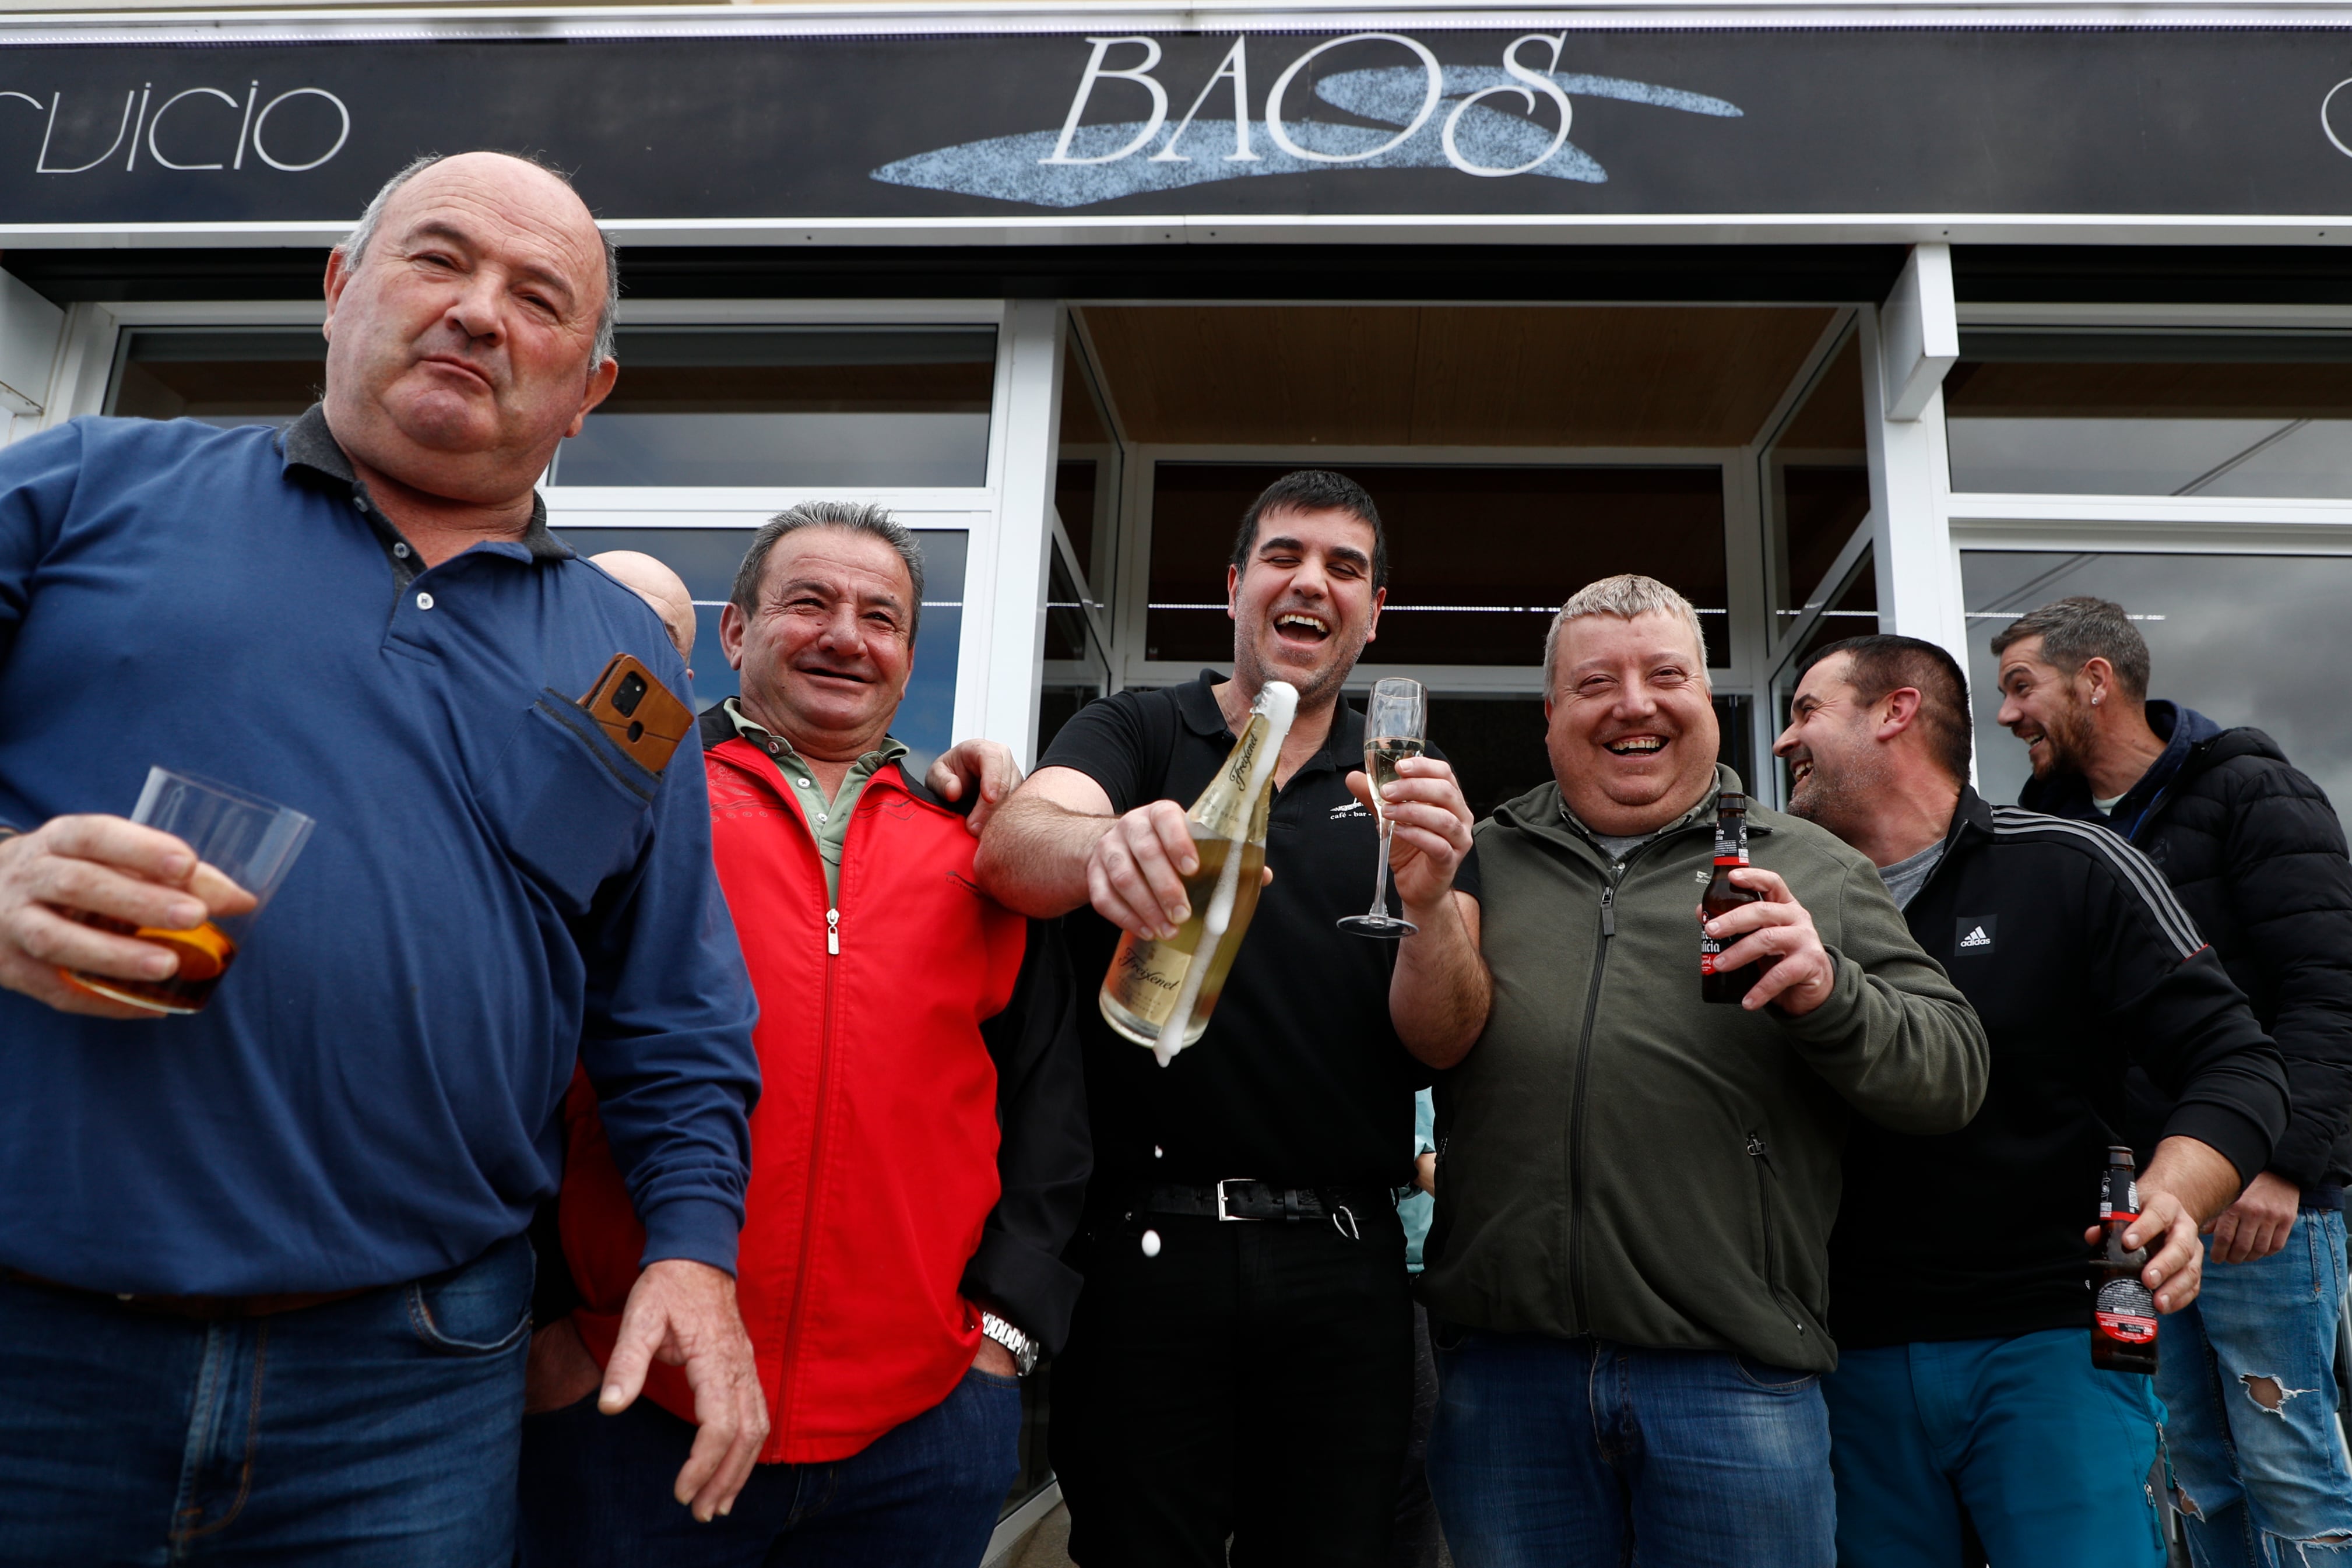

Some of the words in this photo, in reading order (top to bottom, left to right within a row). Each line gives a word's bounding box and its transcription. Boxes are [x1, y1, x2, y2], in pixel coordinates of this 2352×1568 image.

[1038, 30, 1573, 177] BAOS
[1229, 733, 1257, 792] Freixenet
[1960, 938, 1991, 947] adidas
[1118, 947, 1180, 991] Freixenet
